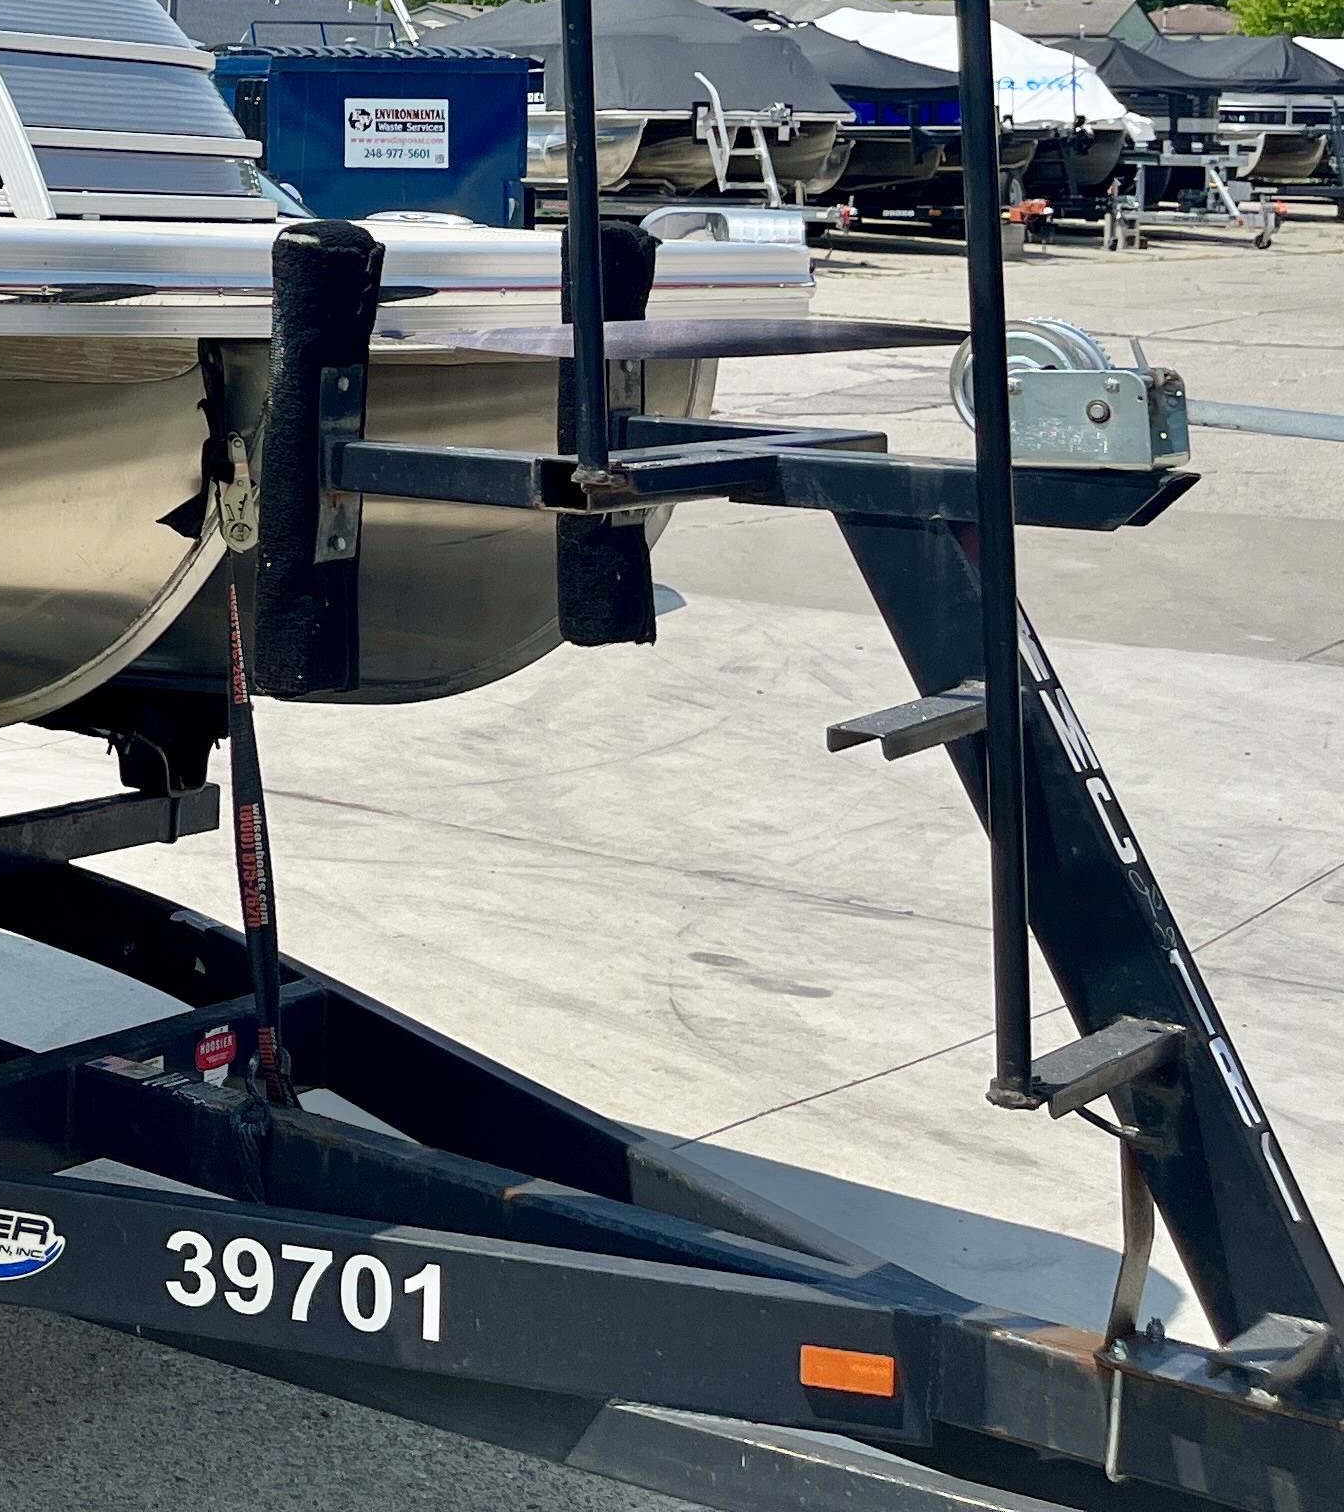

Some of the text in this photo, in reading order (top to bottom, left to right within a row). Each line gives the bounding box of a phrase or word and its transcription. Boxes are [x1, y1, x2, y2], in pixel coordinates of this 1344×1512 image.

[375, 108, 446, 120] ENVIRONMENTAL
[378, 122, 444, 132] Waste Services
[252, 803, 269, 926] wilsonboats.com
[200, 1034, 233, 1056] HOOSIER
[15, 1248, 46, 1260] INC.
[165, 1229, 443, 1342] 39701
